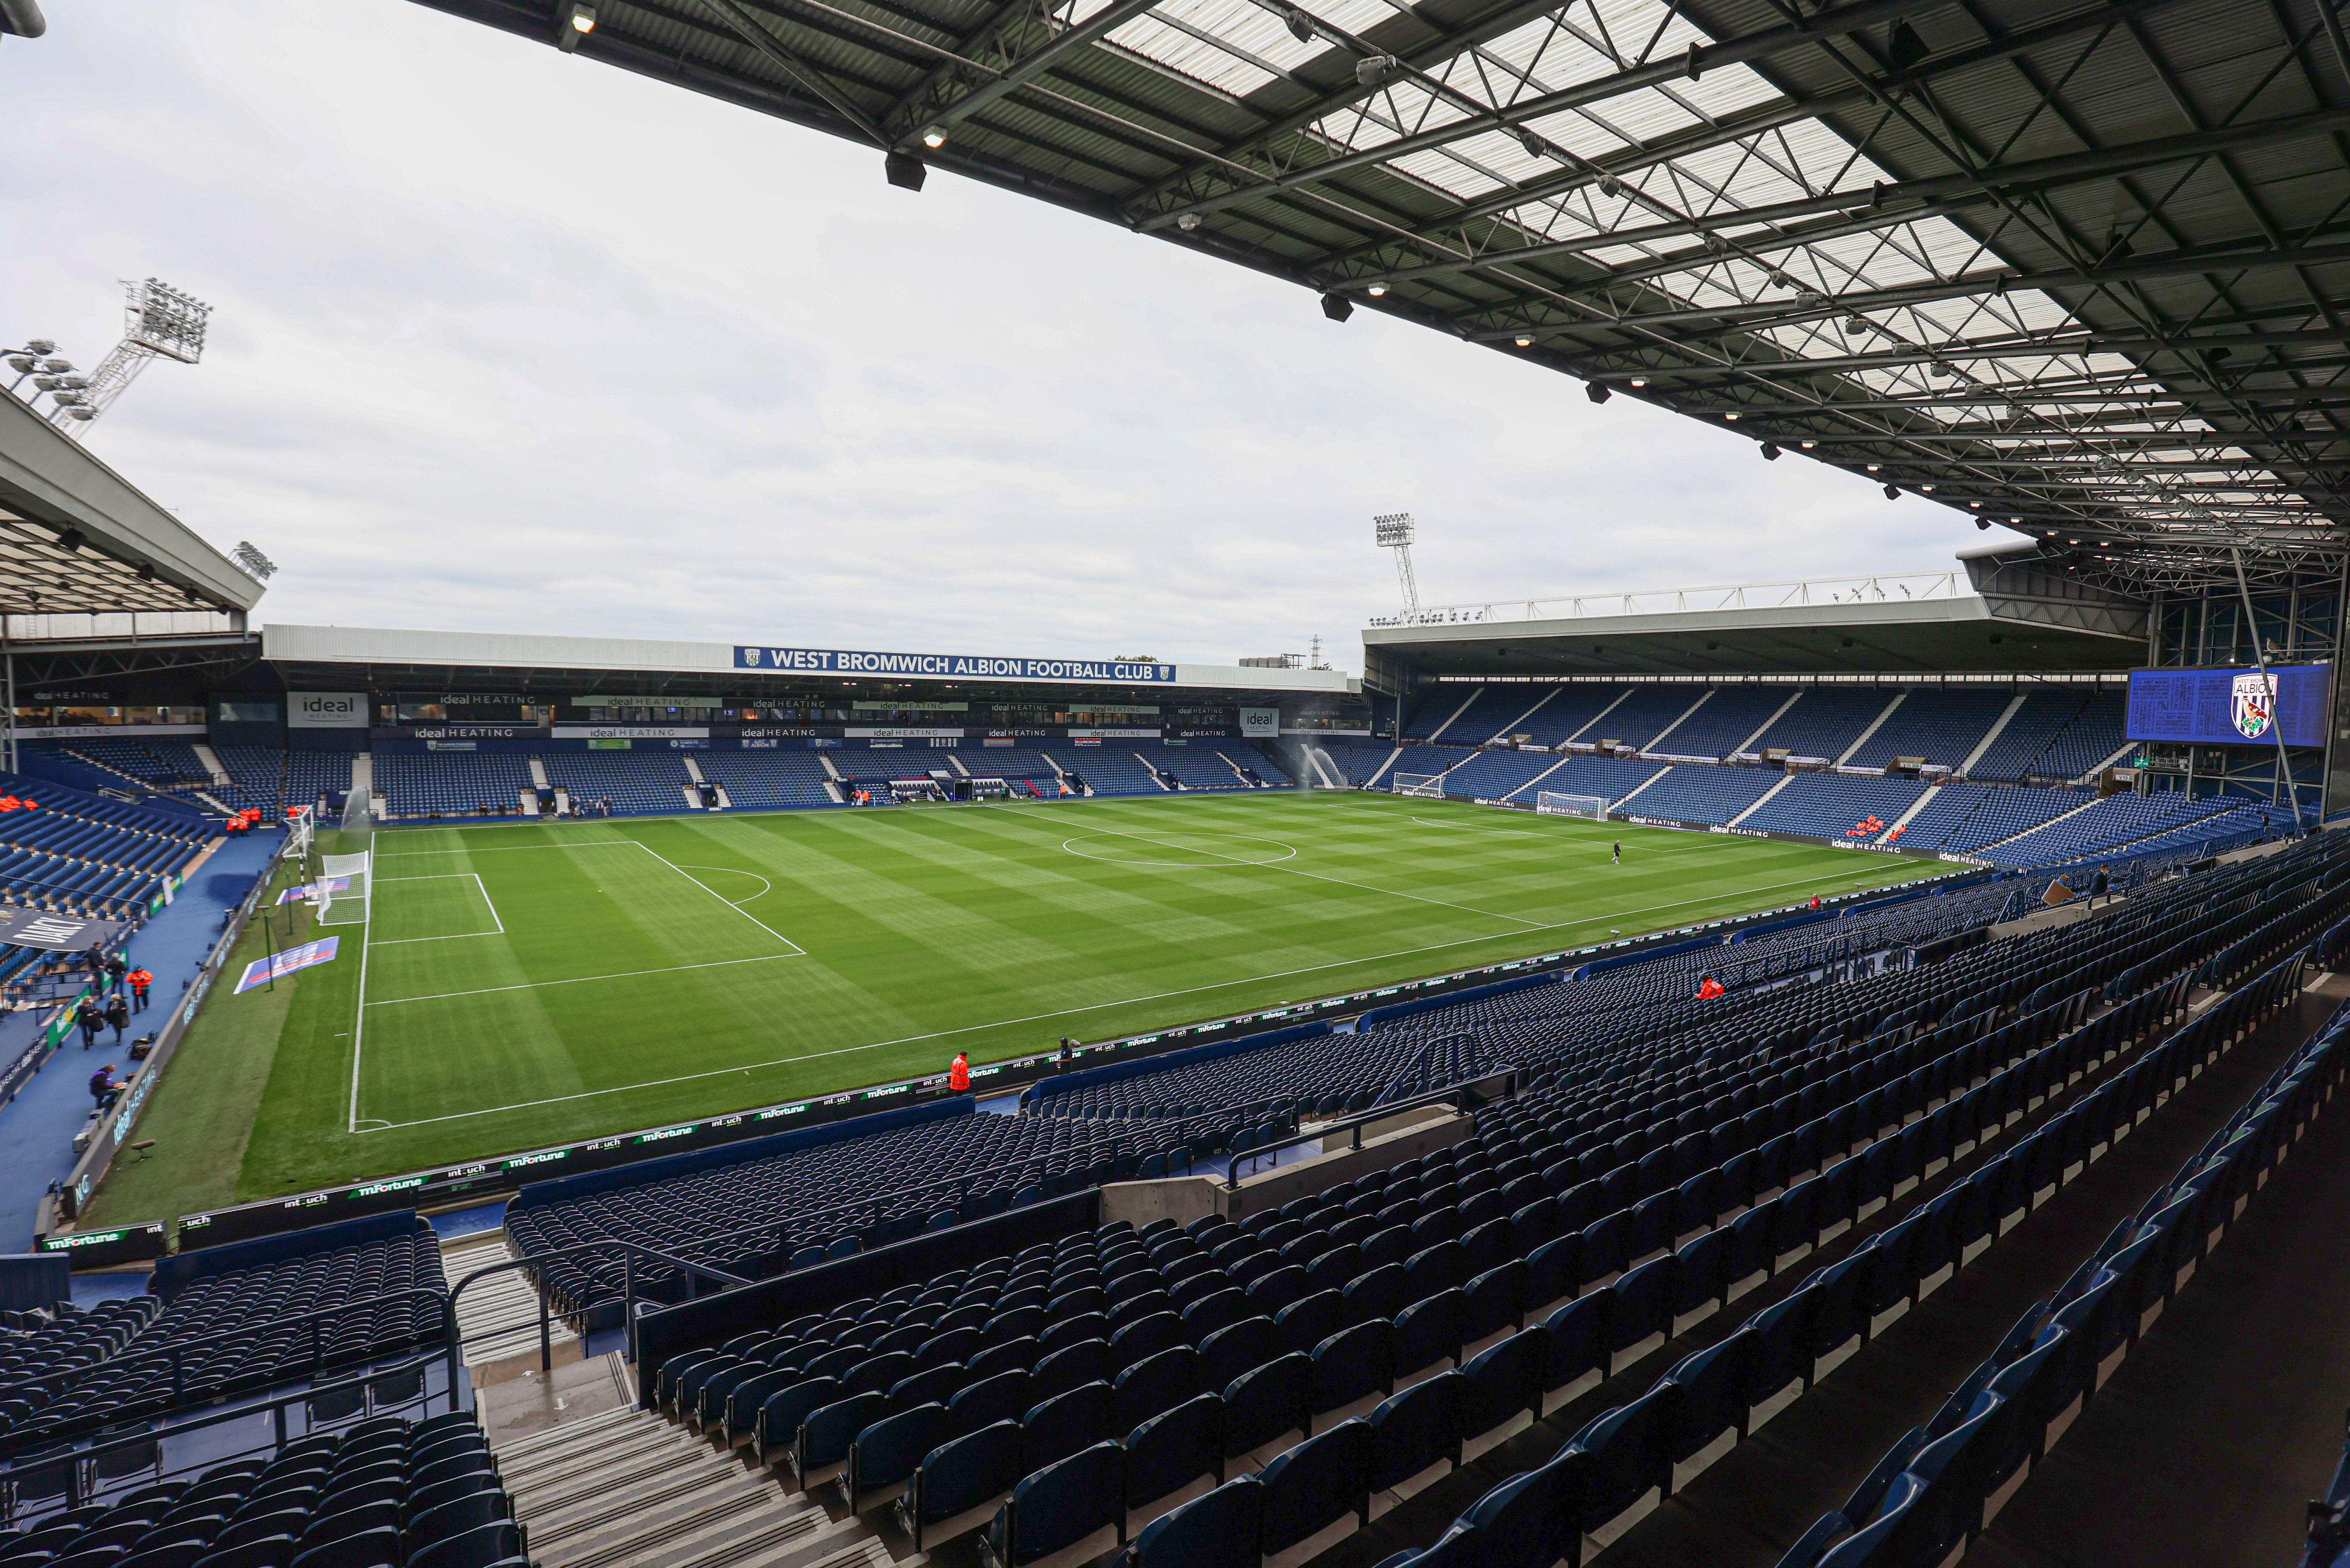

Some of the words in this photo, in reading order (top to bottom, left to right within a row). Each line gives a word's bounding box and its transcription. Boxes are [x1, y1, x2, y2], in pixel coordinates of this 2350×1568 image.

[771, 650, 831, 669] WEST
[838, 653, 949, 672] BROMWICH
[954, 658, 1021, 675] ALBION
[1027, 661, 1110, 678] FOOTBALL
[1114, 665, 1153, 679] CLUB
[303, 697, 353, 712] ideal
[440, 695, 469, 704] ideal
[473, 695, 535, 704] HEATING
[608, 697, 633, 705] ideal
[753, 699, 775, 708] ideal
[1247, 712, 1272, 725] ideal
[415, 728, 445, 738] ideal
[590, 728, 616, 737] ideal
[742, 728, 764, 737] ideal
[1629, 815, 1646, 824] ideal
[1648, 818, 1681, 827] HEATING
[1710, 824, 1729, 834] ideal
[1731, 828, 1768, 838] HEATING
[1832, 839, 1854, 849] ideal
[1857, 843, 1901, 854] HEATING
[1939, 851, 1959, 863] ideal
[13, 916, 87, 944] DARCY
[1426, 978, 1445, 987] mFortune
[1376, 988, 1397, 997] mFortune
[1322, 999, 1345, 1008] mFortune
[1262, 1010, 1287, 1020] mFortune
[1198, 1022, 1226, 1033] mFortune
[1127, 1036, 1157, 1047] mFortune
[867, 1085, 907, 1099] mFortune
[760, 1105, 805, 1119] mFortune
[113, 1099, 132, 1146] ideal
[642, 1127, 692, 1142] mFortune
[509, 1151, 565, 1168] mFortune
[75, 1174, 91, 1206] NG
[358, 1178, 422, 1196] mFortune
[147, 1224, 164, 1233] int
[47, 1233, 119, 1250] mFortune
